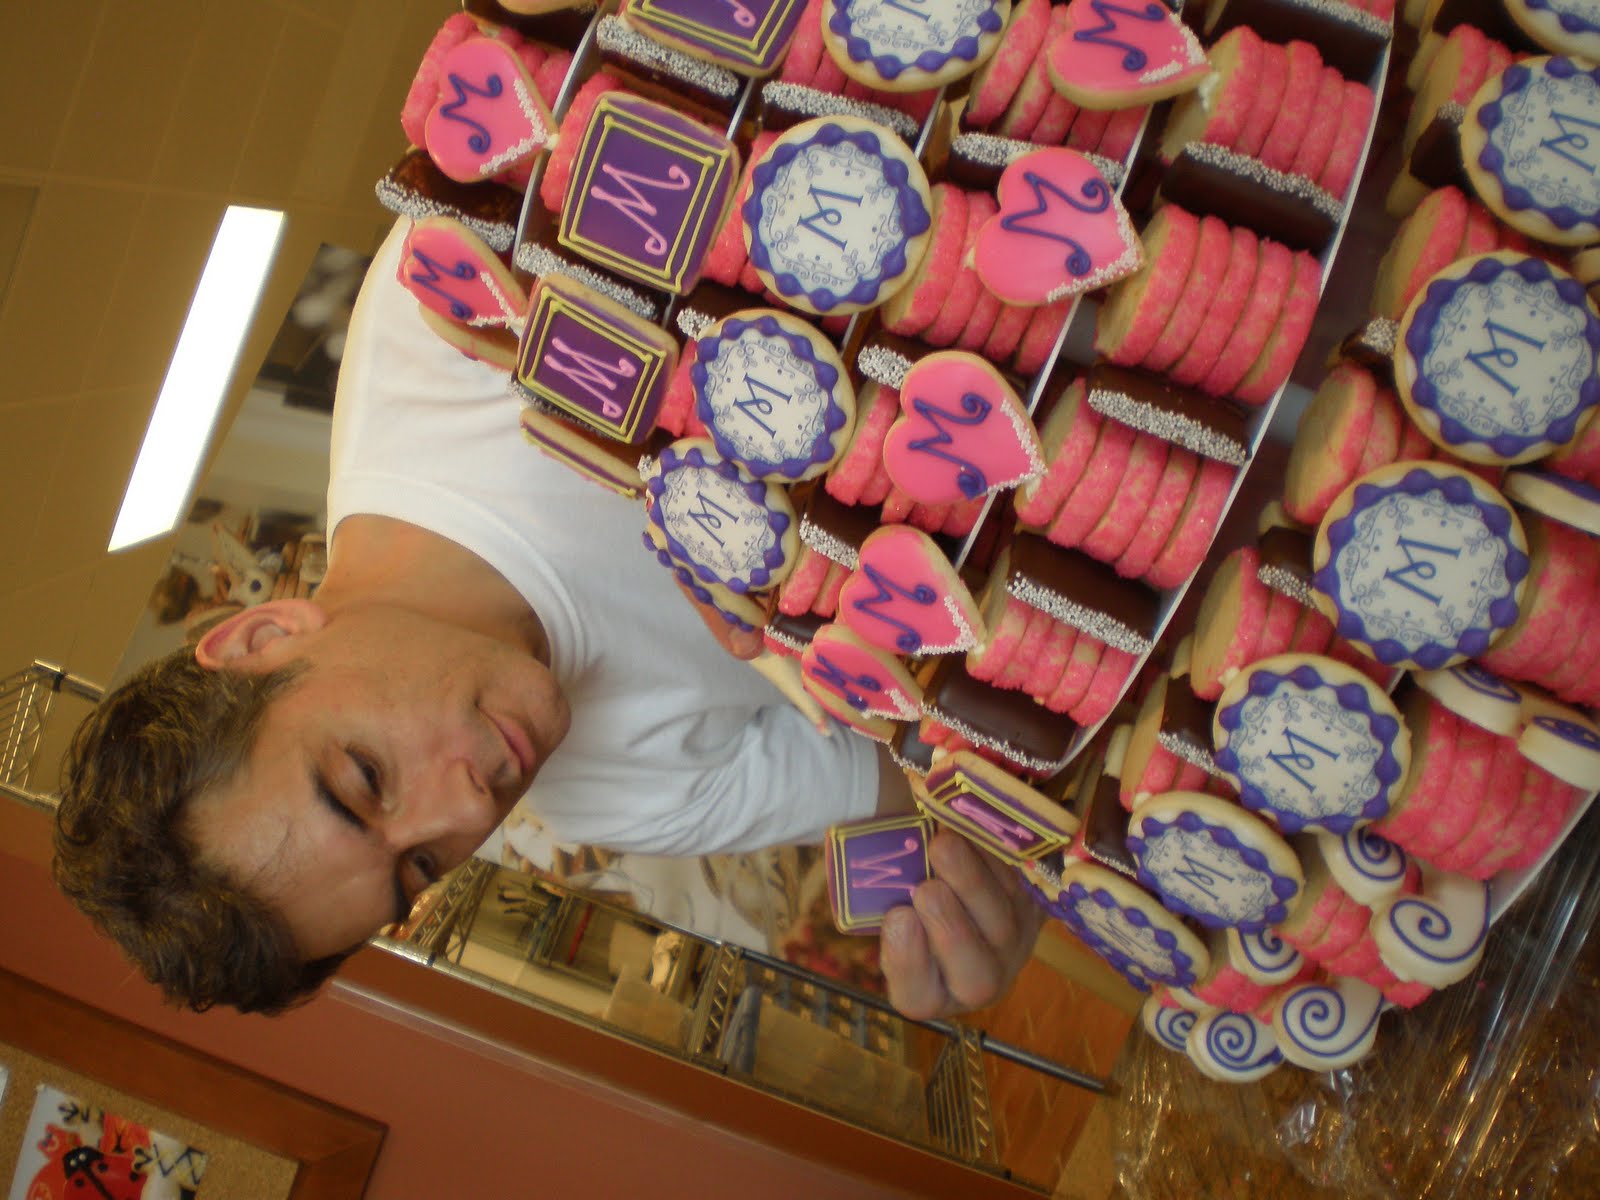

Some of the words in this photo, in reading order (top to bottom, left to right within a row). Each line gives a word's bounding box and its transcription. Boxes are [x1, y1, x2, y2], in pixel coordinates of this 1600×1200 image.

[1073, 0, 1166, 72] M
[440, 72, 503, 155] M
[1540, 108, 1600, 176] M
[591, 163, 691, 256] M
[799, 183, 865, 252] M
[1002, 171, 1109, 277] M
[411, 248, 477, 320] M
[544, 336, 637, 420] M
[1464, 318, 1547, 398] M
[733, 372, 793, 440] M
[907, 392, 992, 500] M
[687, 490, 739, 549] M
[853, 563, 937, 650] M
[1383, 534, 1461, 608] M
[812, 653, 881, 712] M
[1265, 726, 1340, 792] M
[850, 838, 919, 898] M
[1172, 854, 1235, 902] M
